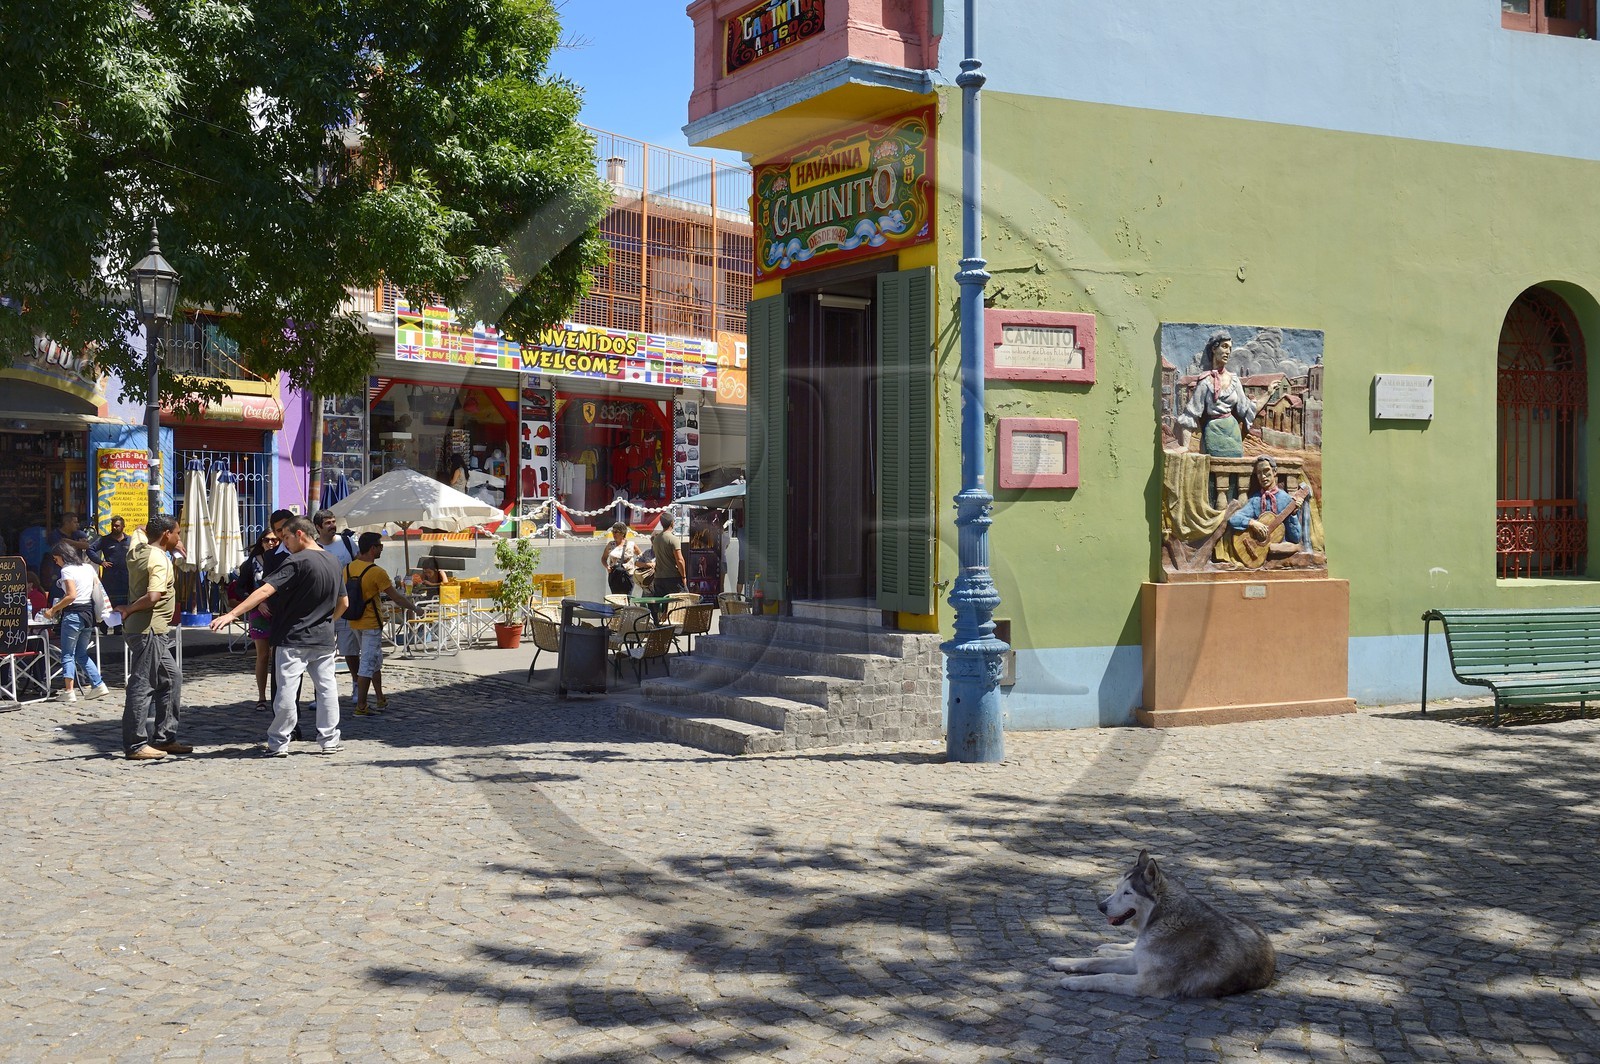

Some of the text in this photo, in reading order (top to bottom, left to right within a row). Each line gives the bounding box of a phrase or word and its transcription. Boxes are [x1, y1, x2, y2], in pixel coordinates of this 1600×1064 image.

[755, 20, 799, 51] AMIGO
[796, 147, 863, 187] HAVANNA
[773, 164, 897, 237] CAMINITO
[809, 227, 846, 249] DESDE 1948
[431, 337, 463, 349] GIFTS
[504, 327, 637, 356] NVENIDOS
[1004, 327, 1072, 346] CAMINITO
[520, 349, 620, 376] WELCOME
[244, 404, 281, 420] Coca-Cola
[114, 460, 148, 470] Filiberto
[3, 589, 27, 608] $55
[9, 584, 25, 593] CHOPP
[0, 607, 21, 616] PLATO
[4, 626, 26, 648] $40
